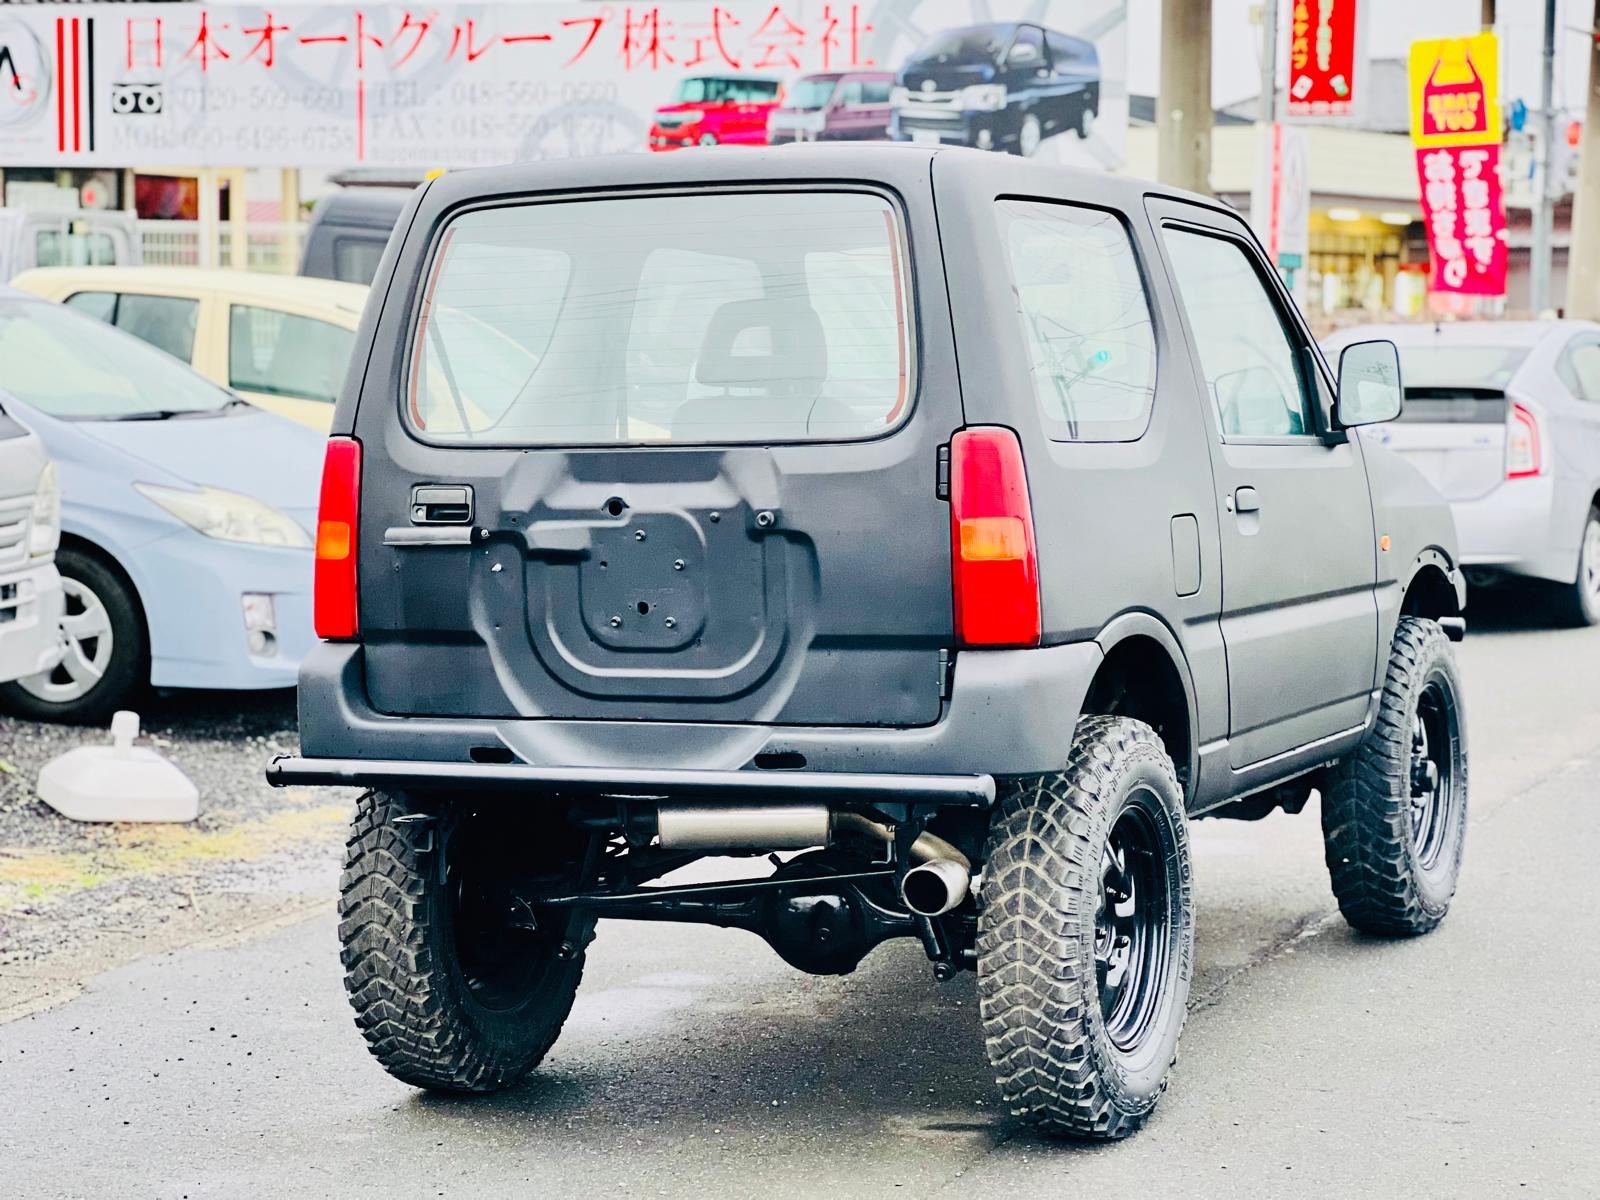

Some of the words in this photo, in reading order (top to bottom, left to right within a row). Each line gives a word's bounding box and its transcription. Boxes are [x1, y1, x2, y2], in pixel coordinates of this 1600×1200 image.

[124, 6, 875, 73] 日本オートグループ株式会社
